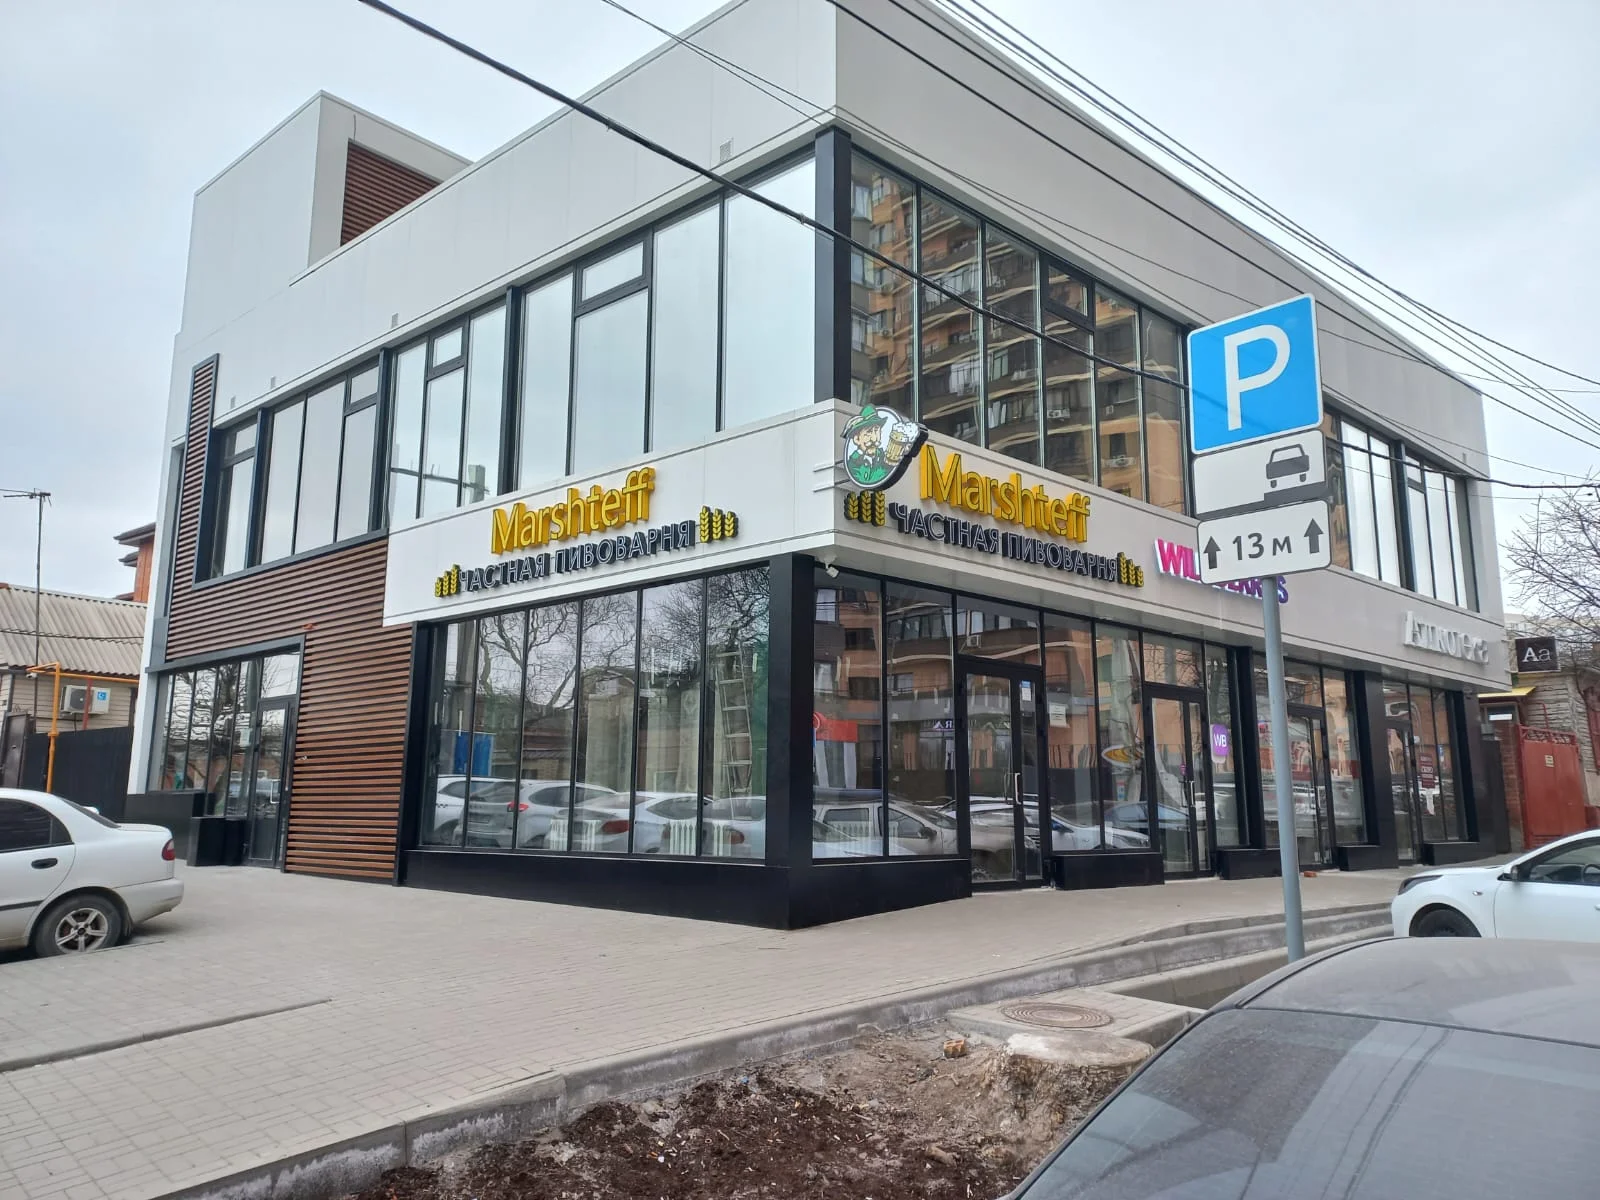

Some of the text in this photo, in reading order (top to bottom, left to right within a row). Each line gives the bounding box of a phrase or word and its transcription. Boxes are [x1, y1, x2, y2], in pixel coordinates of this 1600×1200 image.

[1223, 324, 1291, 431] P
[491, 467, 656, 554] Marshteff
[919, 444, 1091, 544] Marshteff
[459, 519, 696, 592] ЧАСТНАЯ ПИВОВАРНЯ
[889, 502, 1117, 582] ЧАСТНАЯ ПИВОВАРНЯ
[1232, 532, 1264, 560] 13
[1213, 733, 1227, 747] WB
